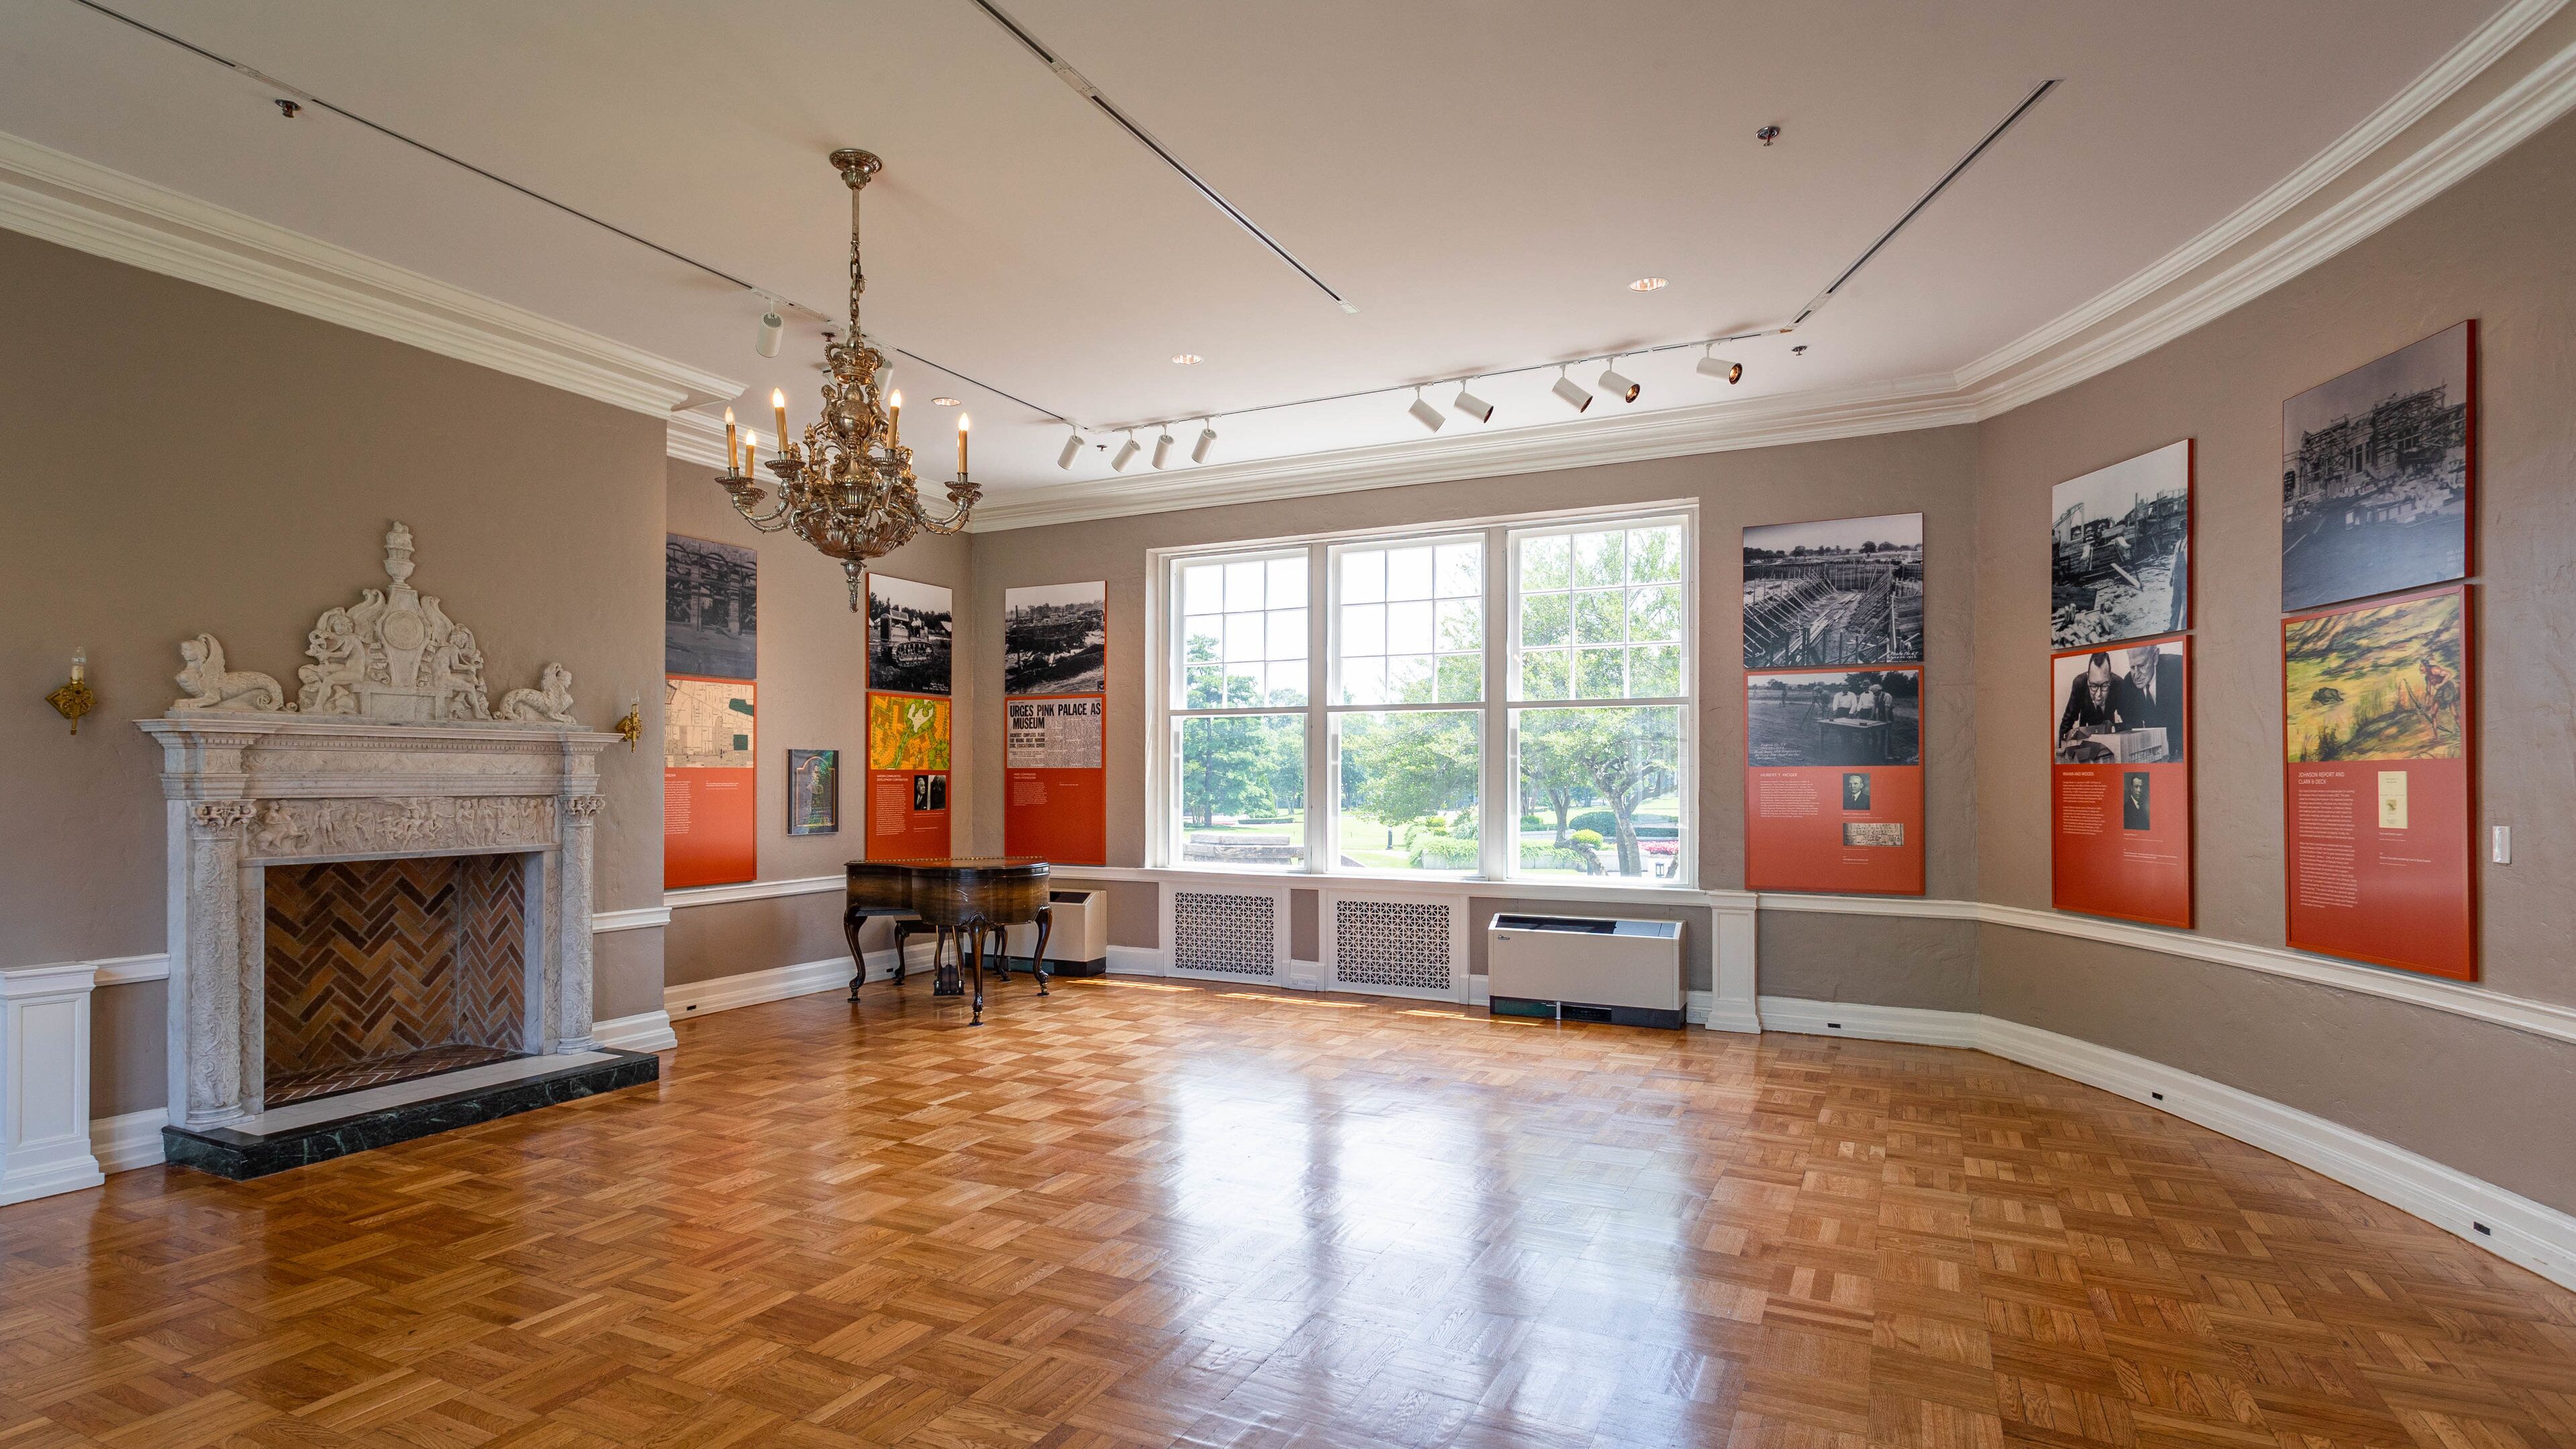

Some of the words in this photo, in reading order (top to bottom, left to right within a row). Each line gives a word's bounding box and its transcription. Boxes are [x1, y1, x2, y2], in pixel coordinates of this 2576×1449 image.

[1010, 704, 1034, 717] URGES
[1036, 704, 1055, 716] PINK
[1058, 703, 1087, 716] PALACE
[1090, 702, 1101, 715] AS
[1013, 716, 1044, 729] MUSEUM
